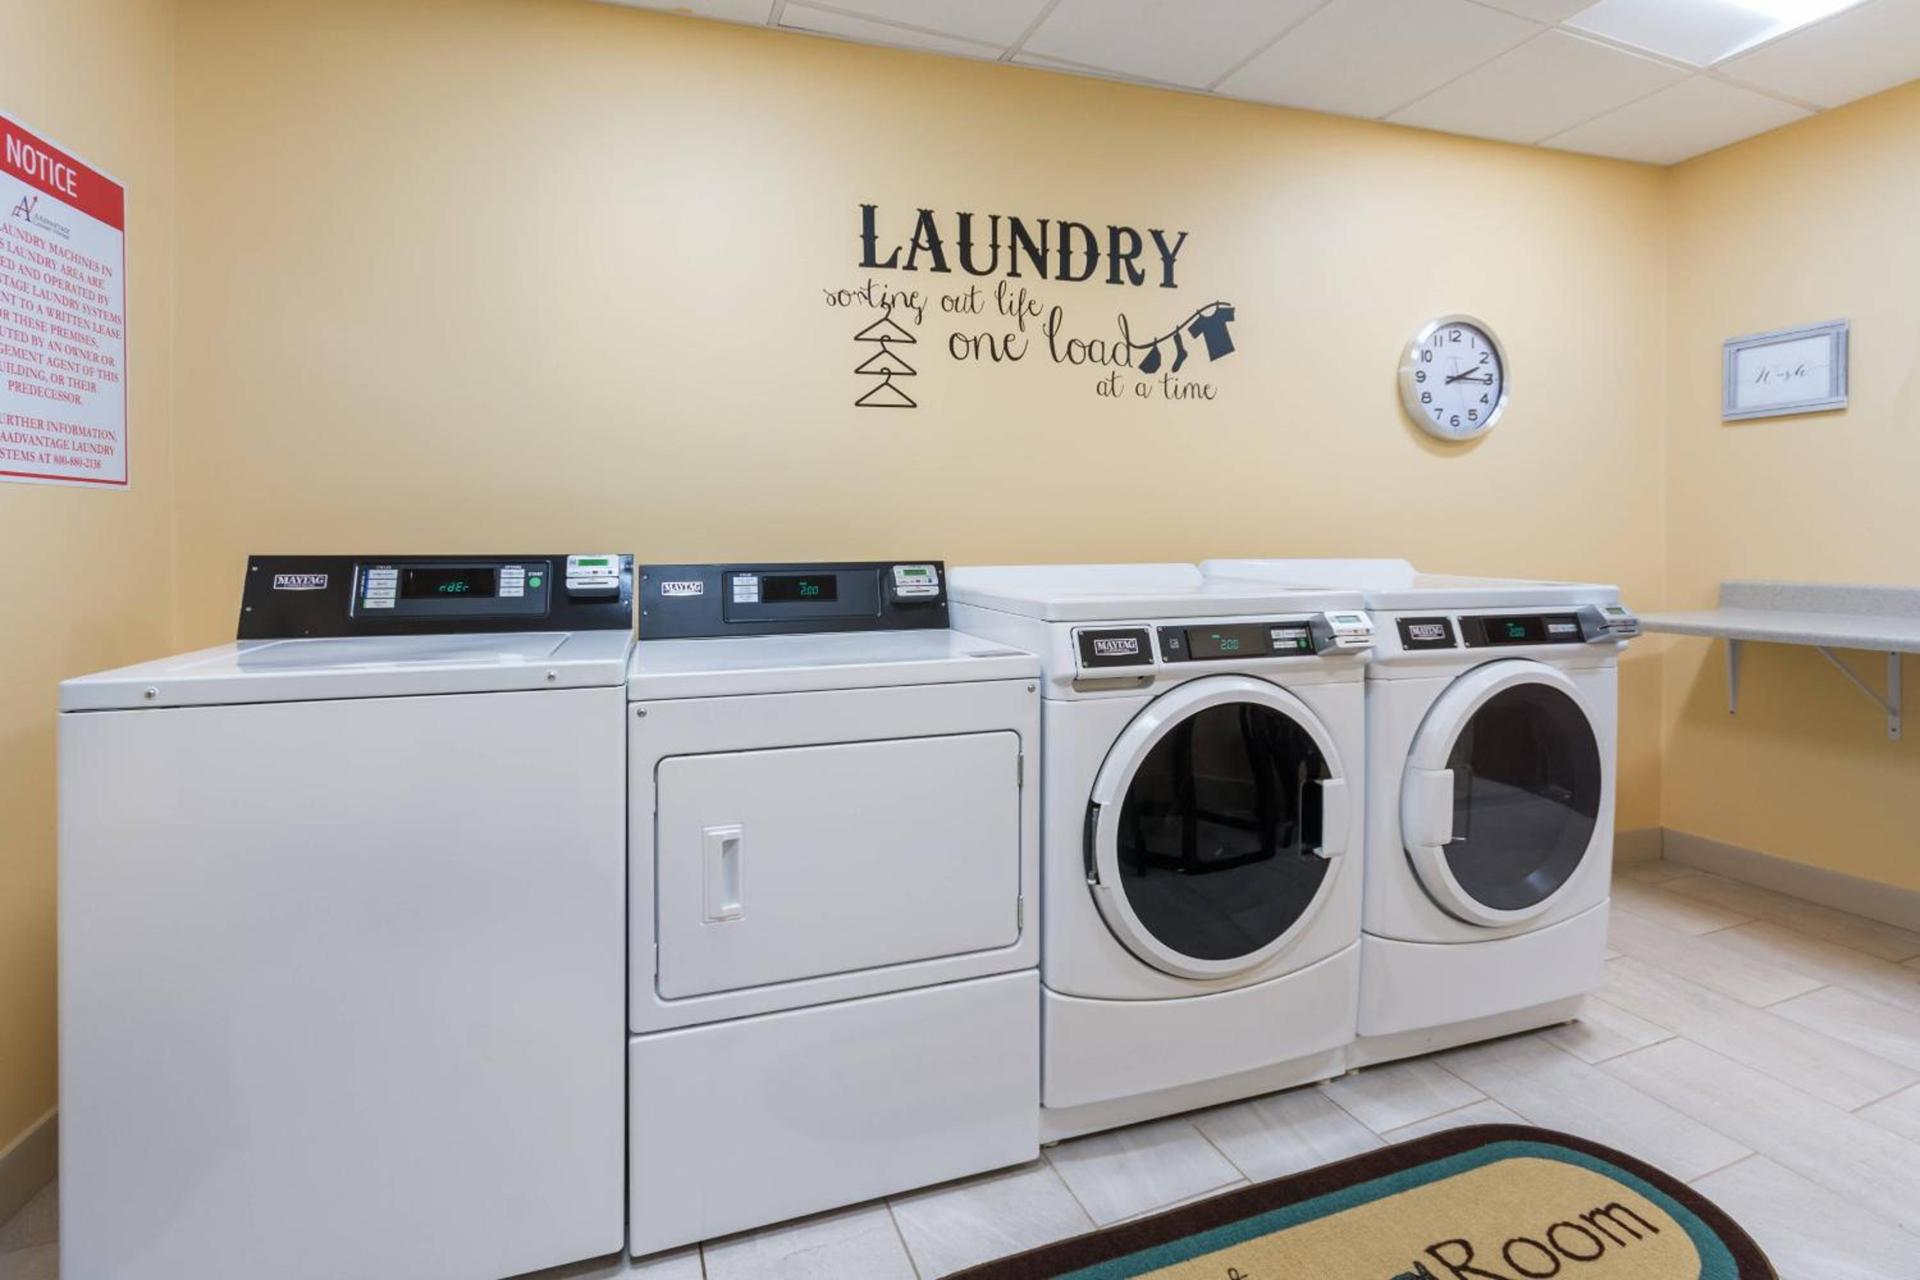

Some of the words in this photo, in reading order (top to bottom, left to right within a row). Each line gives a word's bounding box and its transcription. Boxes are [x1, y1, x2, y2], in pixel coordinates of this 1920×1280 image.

[6, 133, 78, 198] NOTICE
[0, 223, 46, 250] AUNDRY
[49, 242, 99, 273] MACHINES
[102, 265, 112, 278] IN
[858, 203, 1188, 288] LAUNDRY
[8, 241, 57, 270] LAUNDRY
[62, 264, 84, 282] AREA
[87, 275, 105, 291] ARE
[18, 264, 41, 281] AND
[43, 273, 96, 301] OPERATED
[97, 293, 109, 306] BY
[33, 285, 79, 310] LAUNDRY
[82, 304, 122, 325] SYSTEMS
[823, 278, 928, 325] sorting
[941, 284, 985, 314] out
[994, 280, 1044, 332] life
[12, 312, 46, 332] THESE
[20, 297, 34, 311] TO
[37, 304, 43, 315] A
[46, 306, 91, 330] WRITTEN
[93, 322, 122, 340] LEASE
[949, 331, 1029, 362] one
[1043, 305, 1133, 368] load
[1434, 335, 1443, 347] 11
[1448, 329, 1462, 343] 12
[1471, 337, 1475, 349] 1
[31, 335, 43, 348] BY
[48, 340, 61, 354] AN
[64, 344, 99, 363] OWNER
[100, 355, 115, 367] OR
[1421, 350, 1433, 363] 10
[1479, 352, 1490, 364] 2
[46, 356, 81, 374] AGENT
[82, 365, 95, 378] OF
[97, 368, 119, 383] THIS
[1415, 370, 1427, 383] 9
[51, 373, 65, 386] OR
[68, 377, 97, 393] THEIR
[1096, 370, 1125, 398] at
[1135, 381, 1152, 399] a
[1158, 372, 1217, 400] time
[1483, 373, 1494, 386] 3
[1421, 391, 1432, 404] 8
[1479, 393, 1489, 405] 4
[1434, 408, 1444, 420] 7
[1449, 415, 1460, 427] 6
[1468, 409, 1478, 421] 5
[72, 441, 115, 457] LAUNDRY
[39, 453, 51, 465] AT
[277, 575, 324, 585] MAYTAG
[663, 583, 702, 593] MAYTAG
[1412, 625, 1443, 637] MAYTAG
[1096, 639, 1136, 650] MAYTAG
[1424, 1200, 1661, 1280] Room
